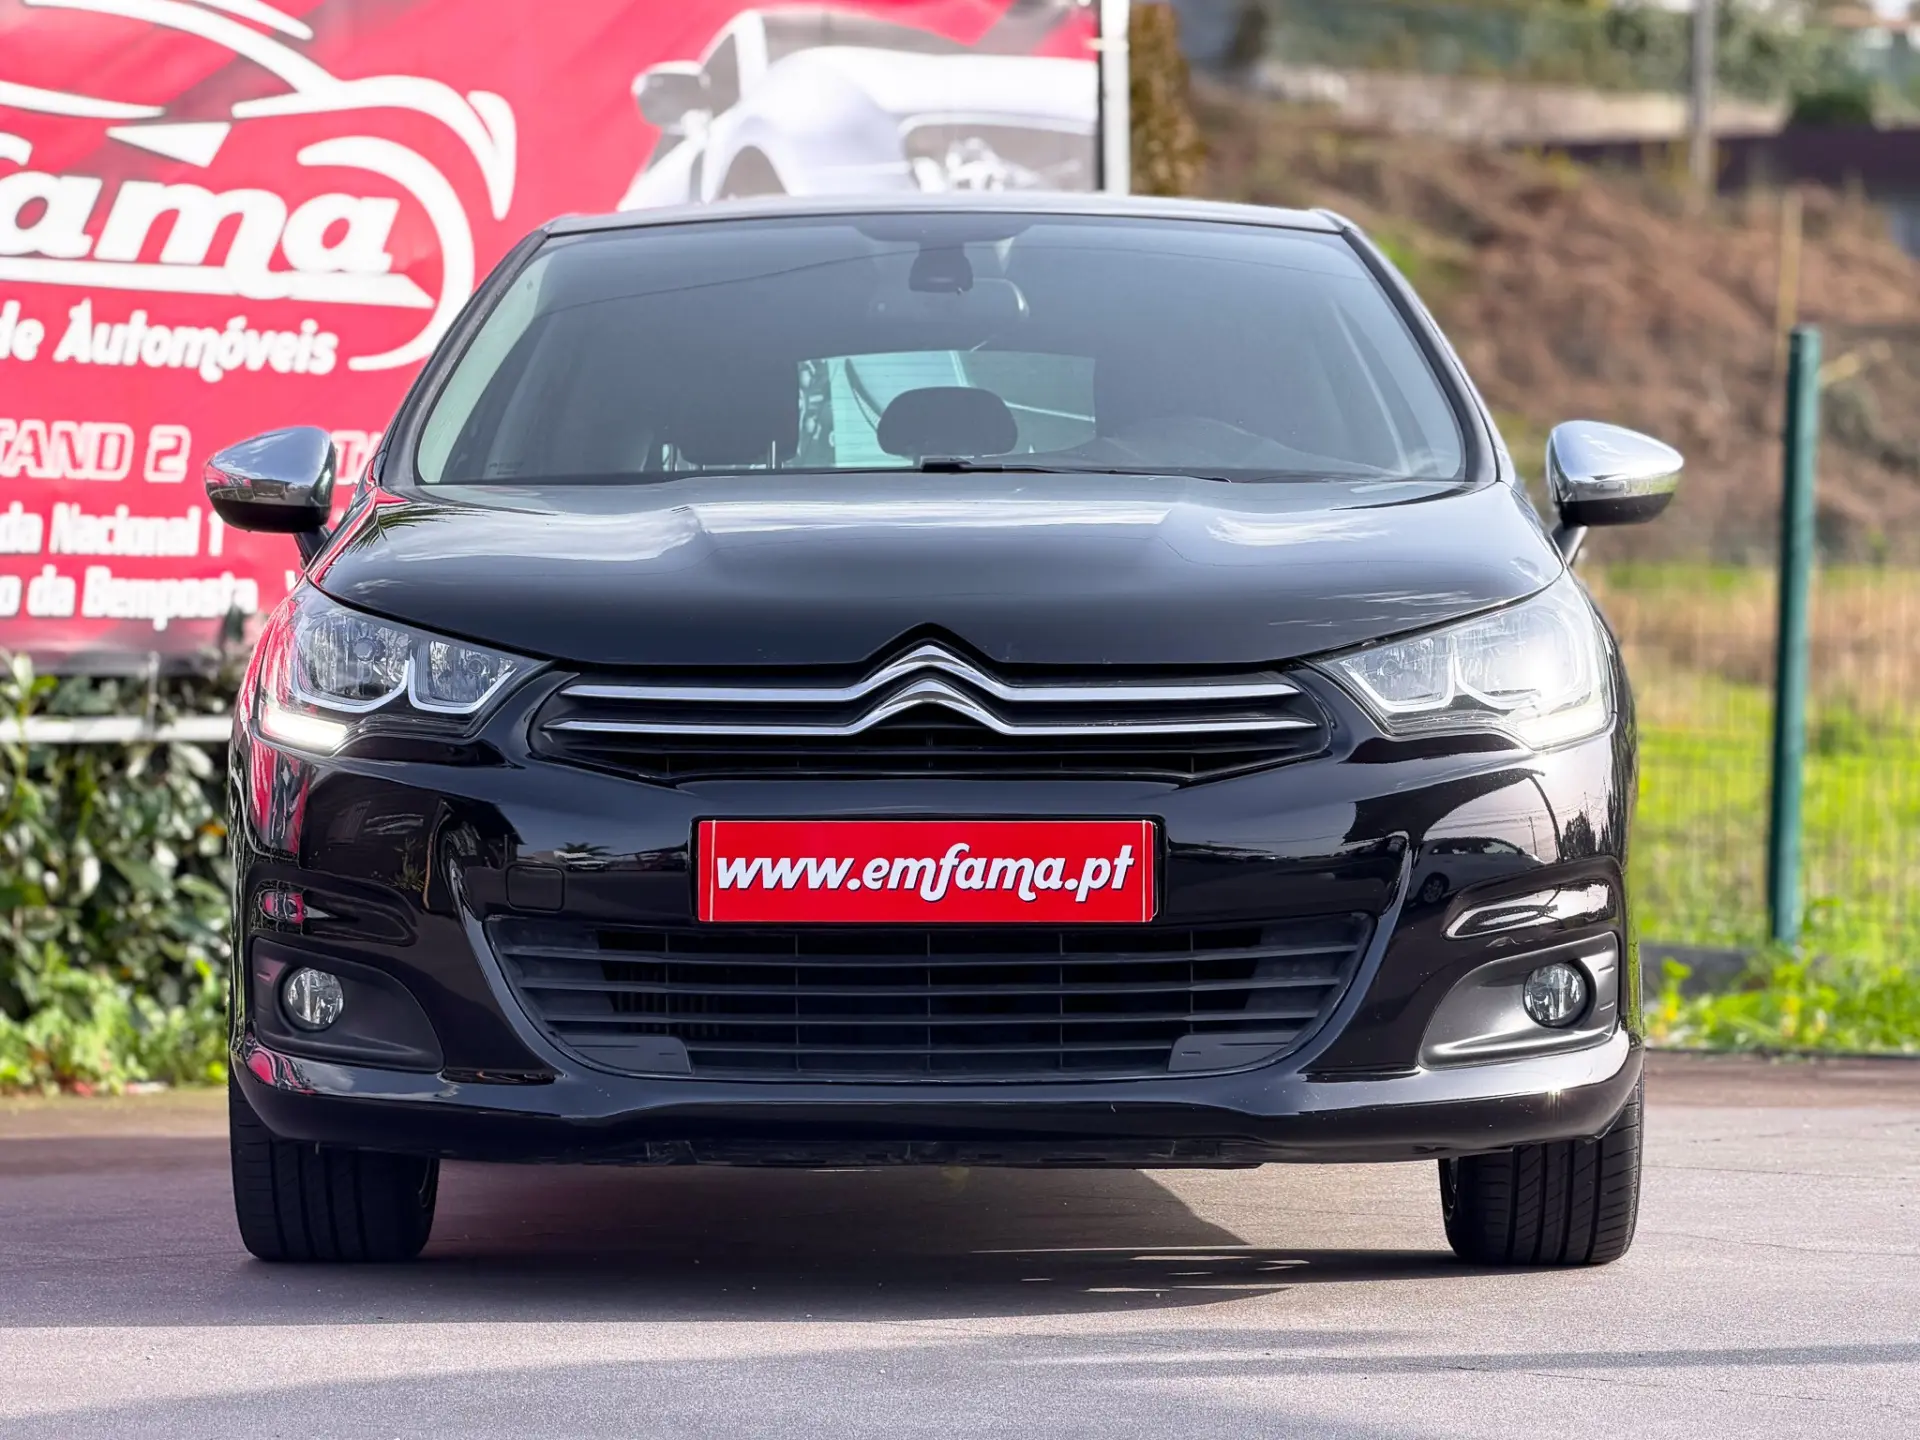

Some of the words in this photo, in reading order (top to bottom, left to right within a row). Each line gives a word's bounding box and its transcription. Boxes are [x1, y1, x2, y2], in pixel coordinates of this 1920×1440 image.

[0, 132, 400, 299] ama
[145, 424, 190, 483] 2
[48, 502, 201, 556] Nacional
[26, 564, 76, 618] da
[81, 566, 258, 631] Bemposta
[716, 843, 1135, 902] www.emfama.pt
